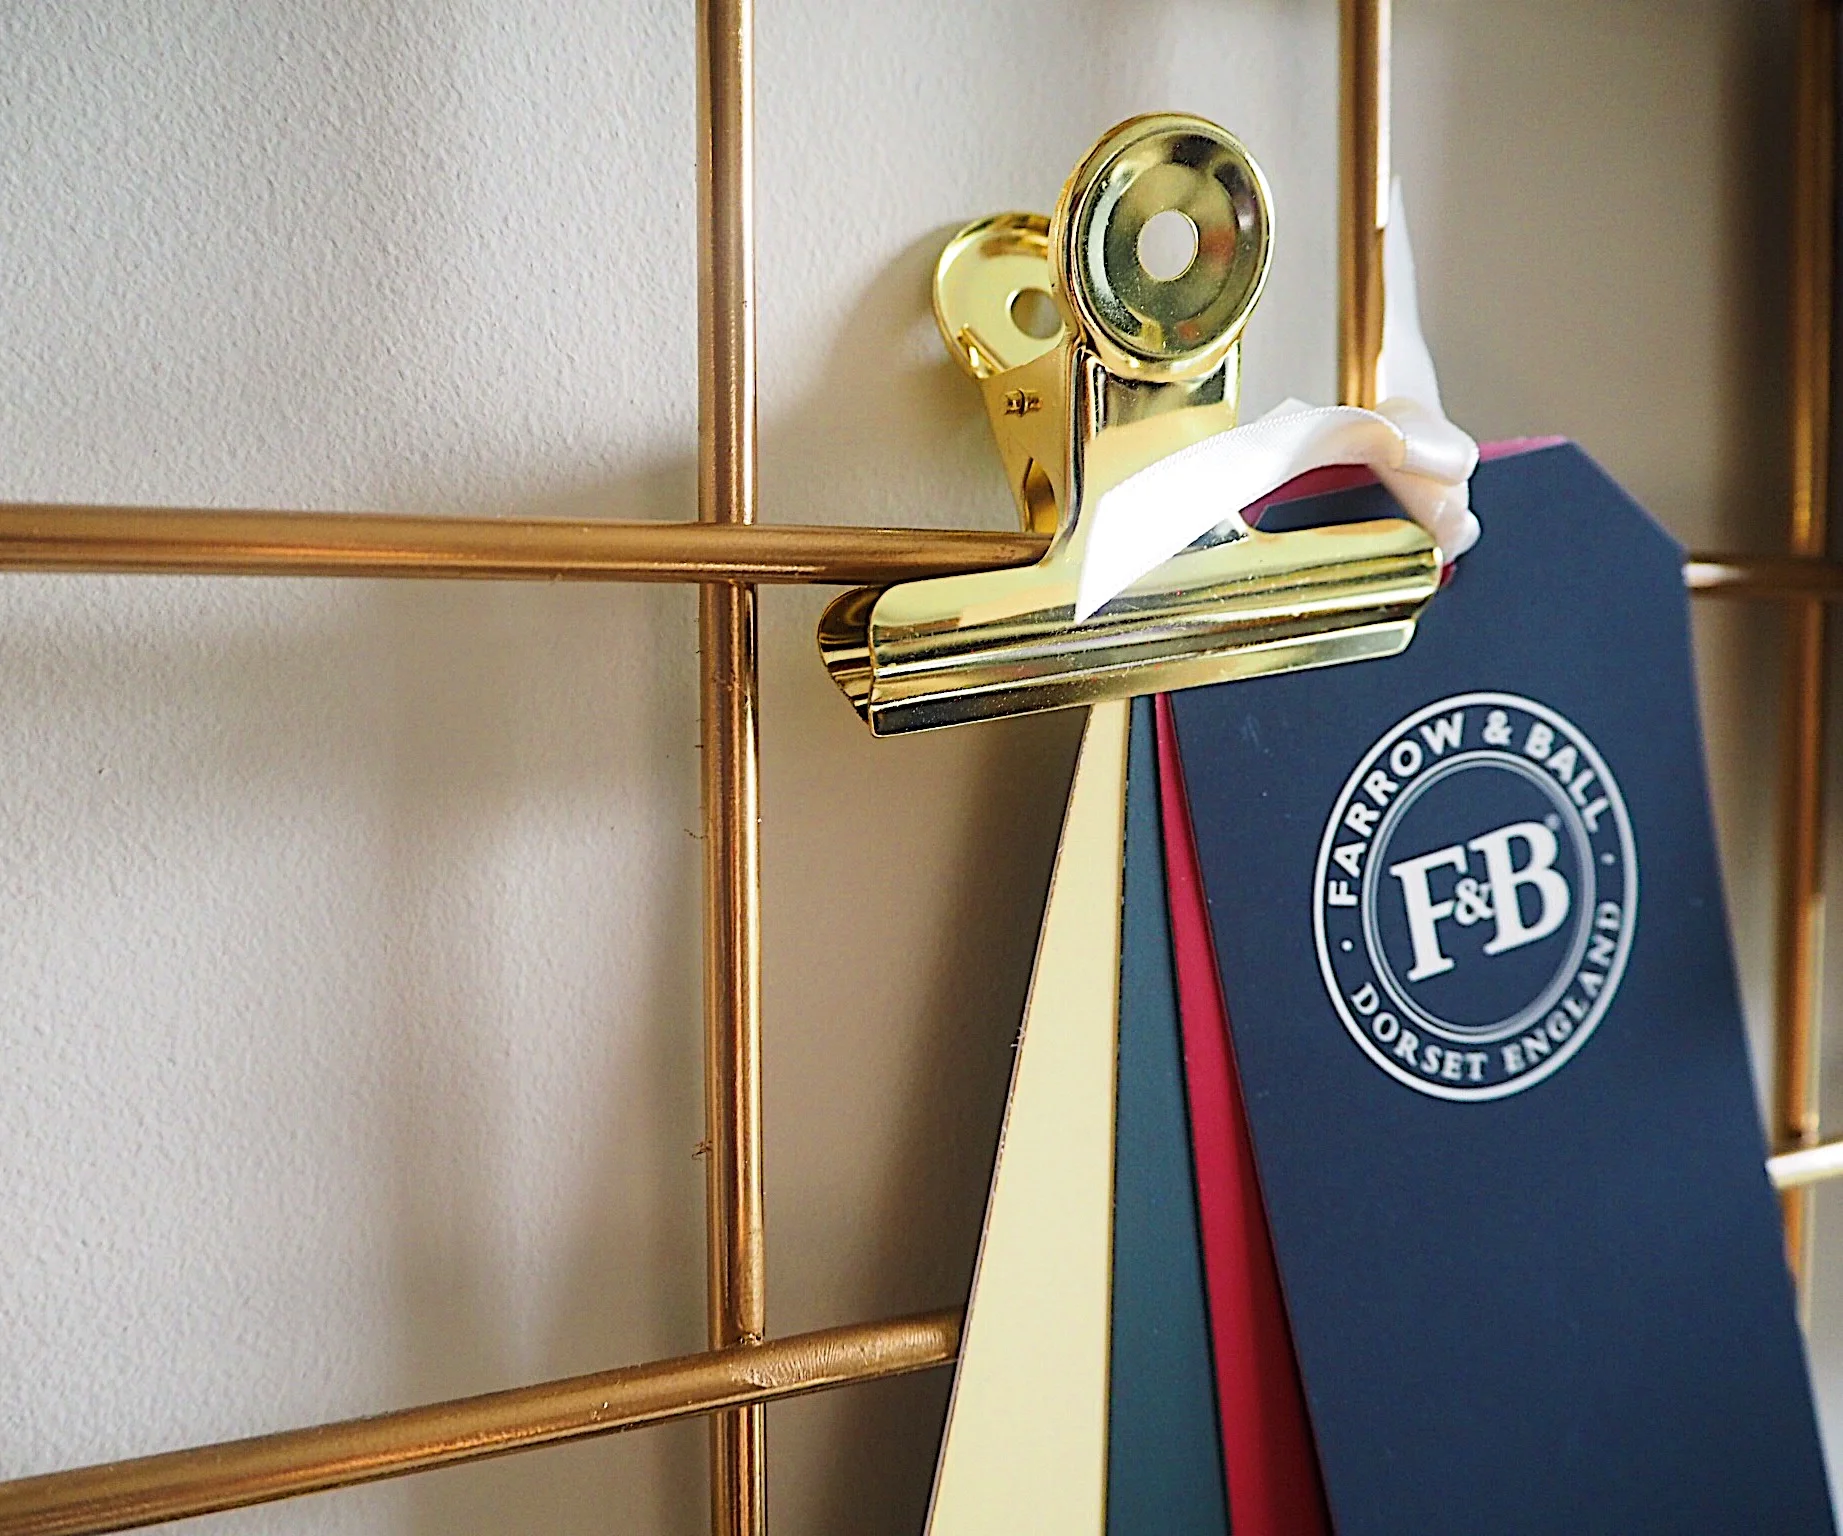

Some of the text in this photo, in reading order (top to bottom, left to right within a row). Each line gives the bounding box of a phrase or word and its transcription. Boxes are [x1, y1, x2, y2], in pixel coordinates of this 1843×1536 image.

[1328, 709, 1611, 906] FARROW & BALL
[1351, 901, 1622, 1081] DORSET ENGLAND
